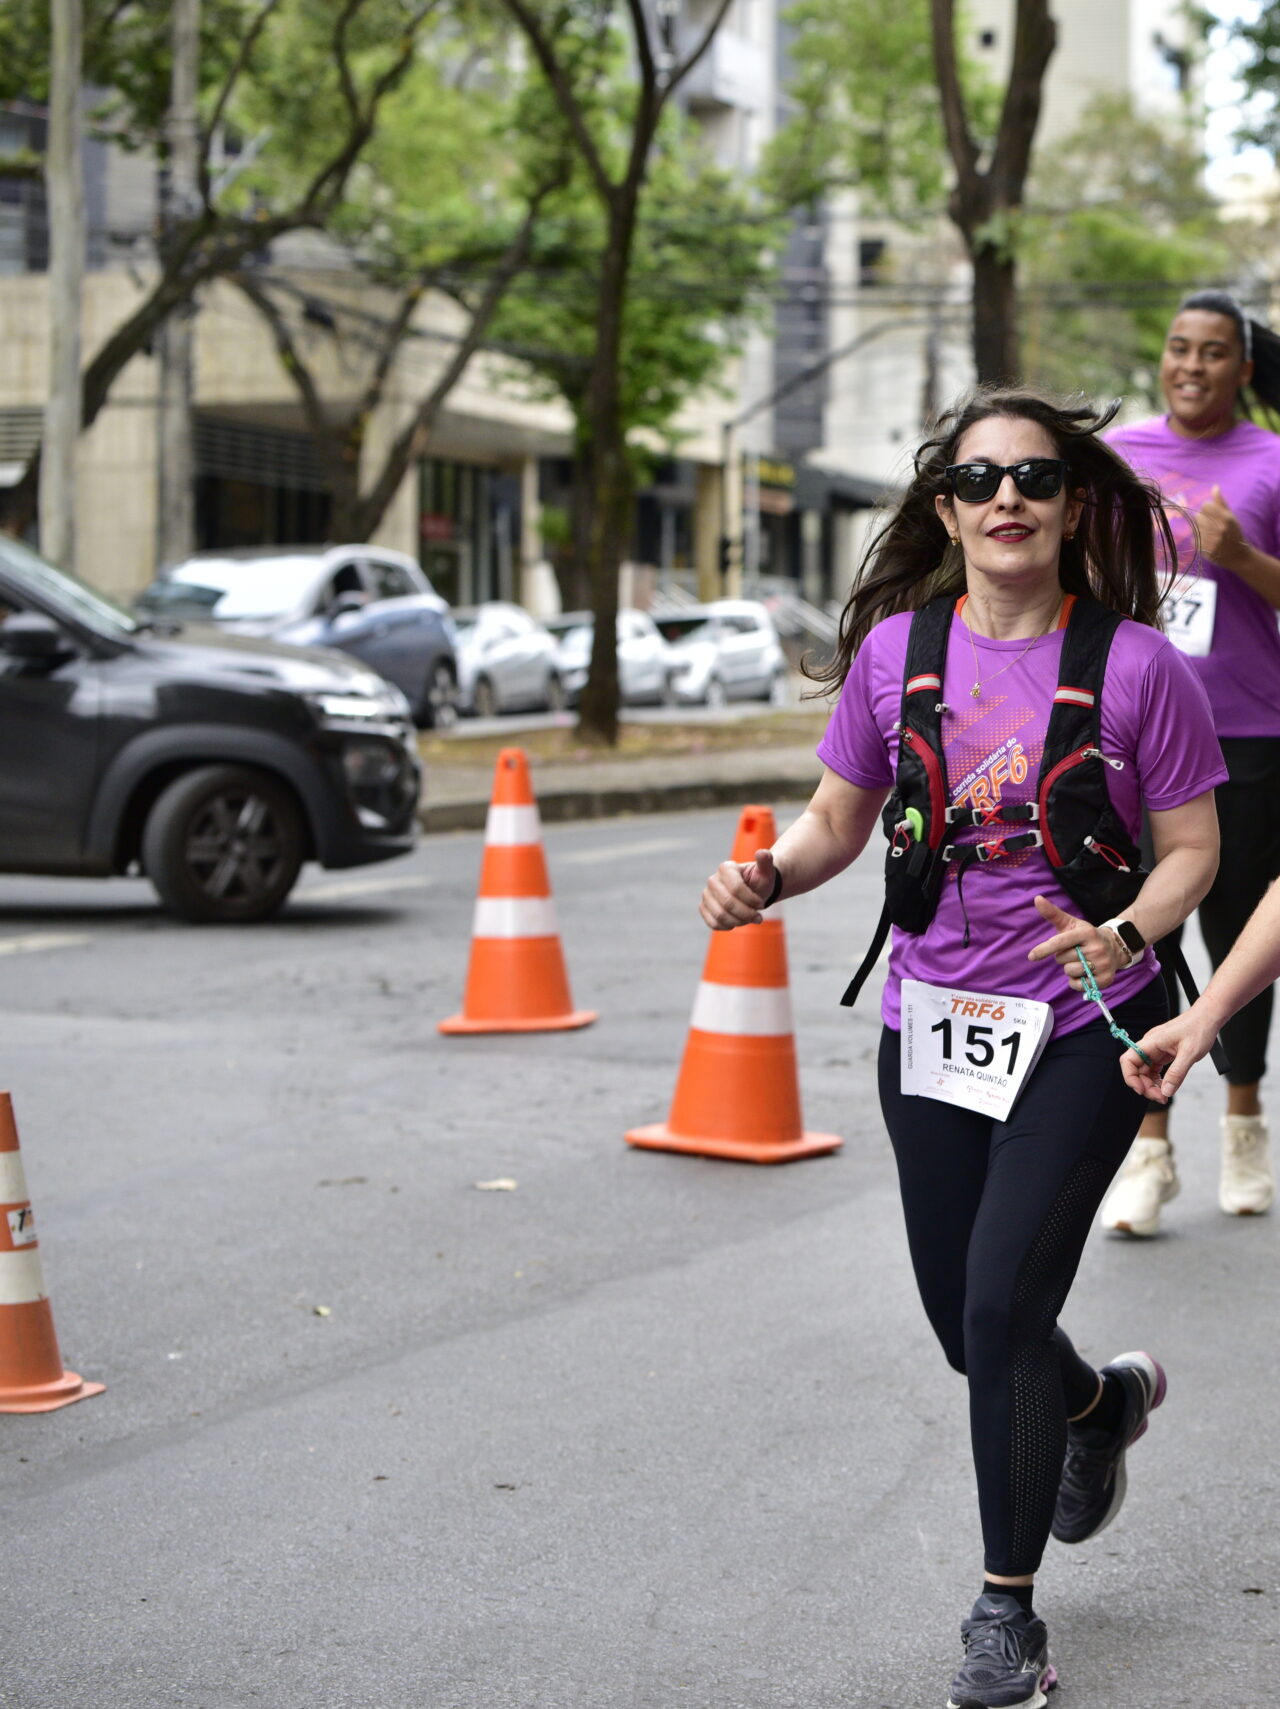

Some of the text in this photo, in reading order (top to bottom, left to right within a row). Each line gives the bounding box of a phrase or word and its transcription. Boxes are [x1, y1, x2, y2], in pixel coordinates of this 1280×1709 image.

[1162, 597, 1202, 626] 37
[953, 737, 1017, 796] corrida solidária do
[951, 999, 1006, 1021] TRF6
[931, 1018, 1022, 1076] 151
[942, 1063, 1008, 1087] RENATA QUINTÃO
